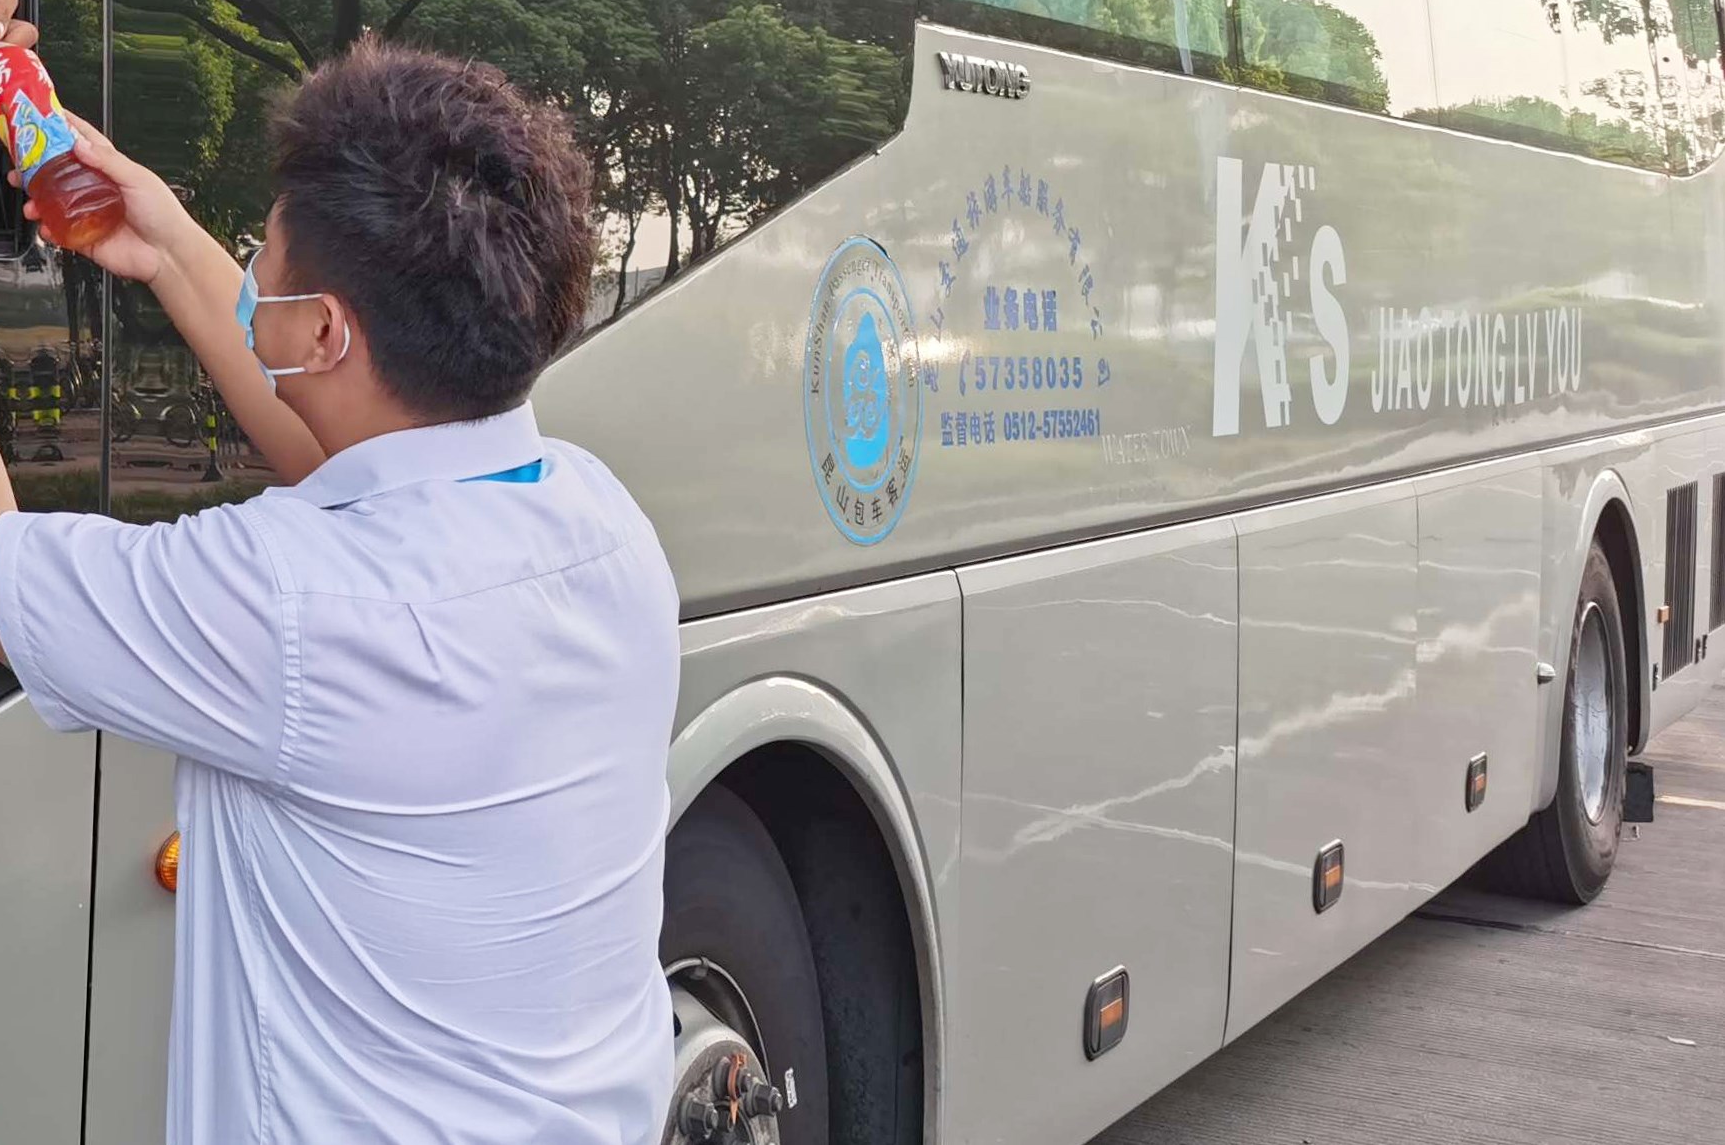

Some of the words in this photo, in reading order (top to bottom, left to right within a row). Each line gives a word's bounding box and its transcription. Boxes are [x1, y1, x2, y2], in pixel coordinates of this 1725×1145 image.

[936, 51, 1031, 99] YUTONG
[984, 286, 1058, 332] 业务电话
[975, 356, 1083, 391] 57358035
[1371, 307, 1434, 414] JIAO
[1441, 309, 1507, 409] TONG
[1514, 312, 1539, 405] LV
[1545, 306, 1583, 395] YOU
[940, 410, 996, 446] 监督电话
[1003, 408, 1101, 442] 0512-57552461
